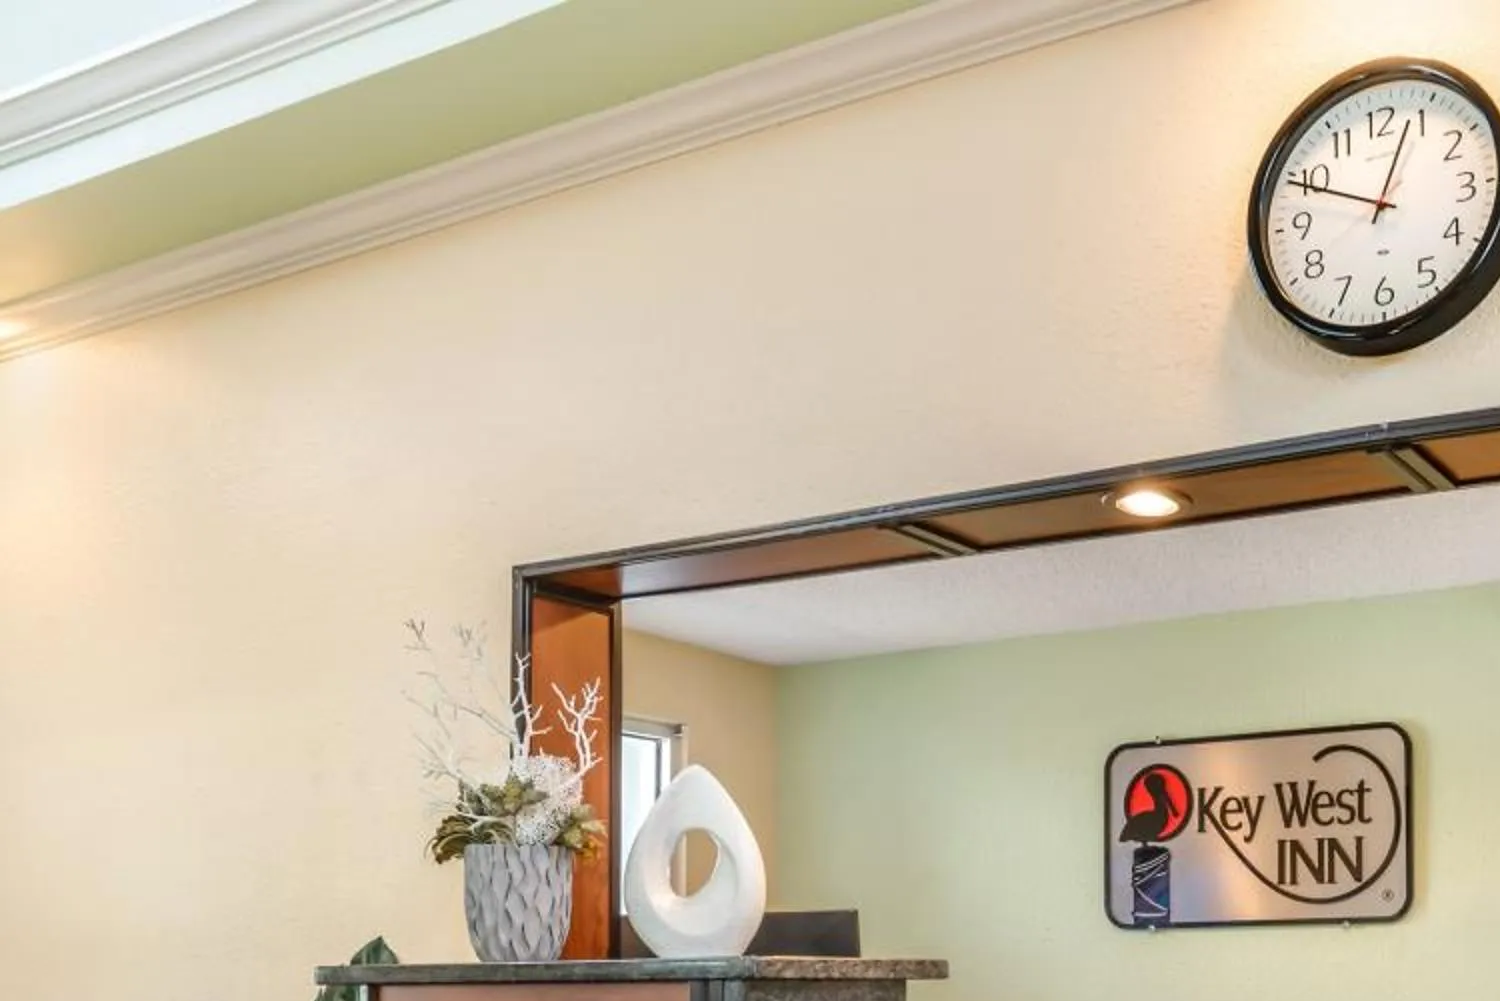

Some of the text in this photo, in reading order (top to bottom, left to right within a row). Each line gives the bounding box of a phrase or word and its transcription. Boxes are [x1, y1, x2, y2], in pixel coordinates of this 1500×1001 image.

[1367, 106, 1396, 139] 12
[1418, 108, 1426, 137] 1
[1332, 128, 1352, 158] 11
[1443, 130, 1463, 161] 2
[1302, 163, 1331, 196] 10
[1456, 171, 1477, 203] 3
[1292, 211, 1313, 240] 9
[1442, 216, 1465, 246] 4
[1304, 249, 1326, 280] 8
[1417, 255, 1437, 288] 5
[1334, 274, 1353, 307] 7
[1374, 275, 1396, 307] 6
[1196, 778, 1373, 843] Key West
[1277, 836, 1365, 886] INN
